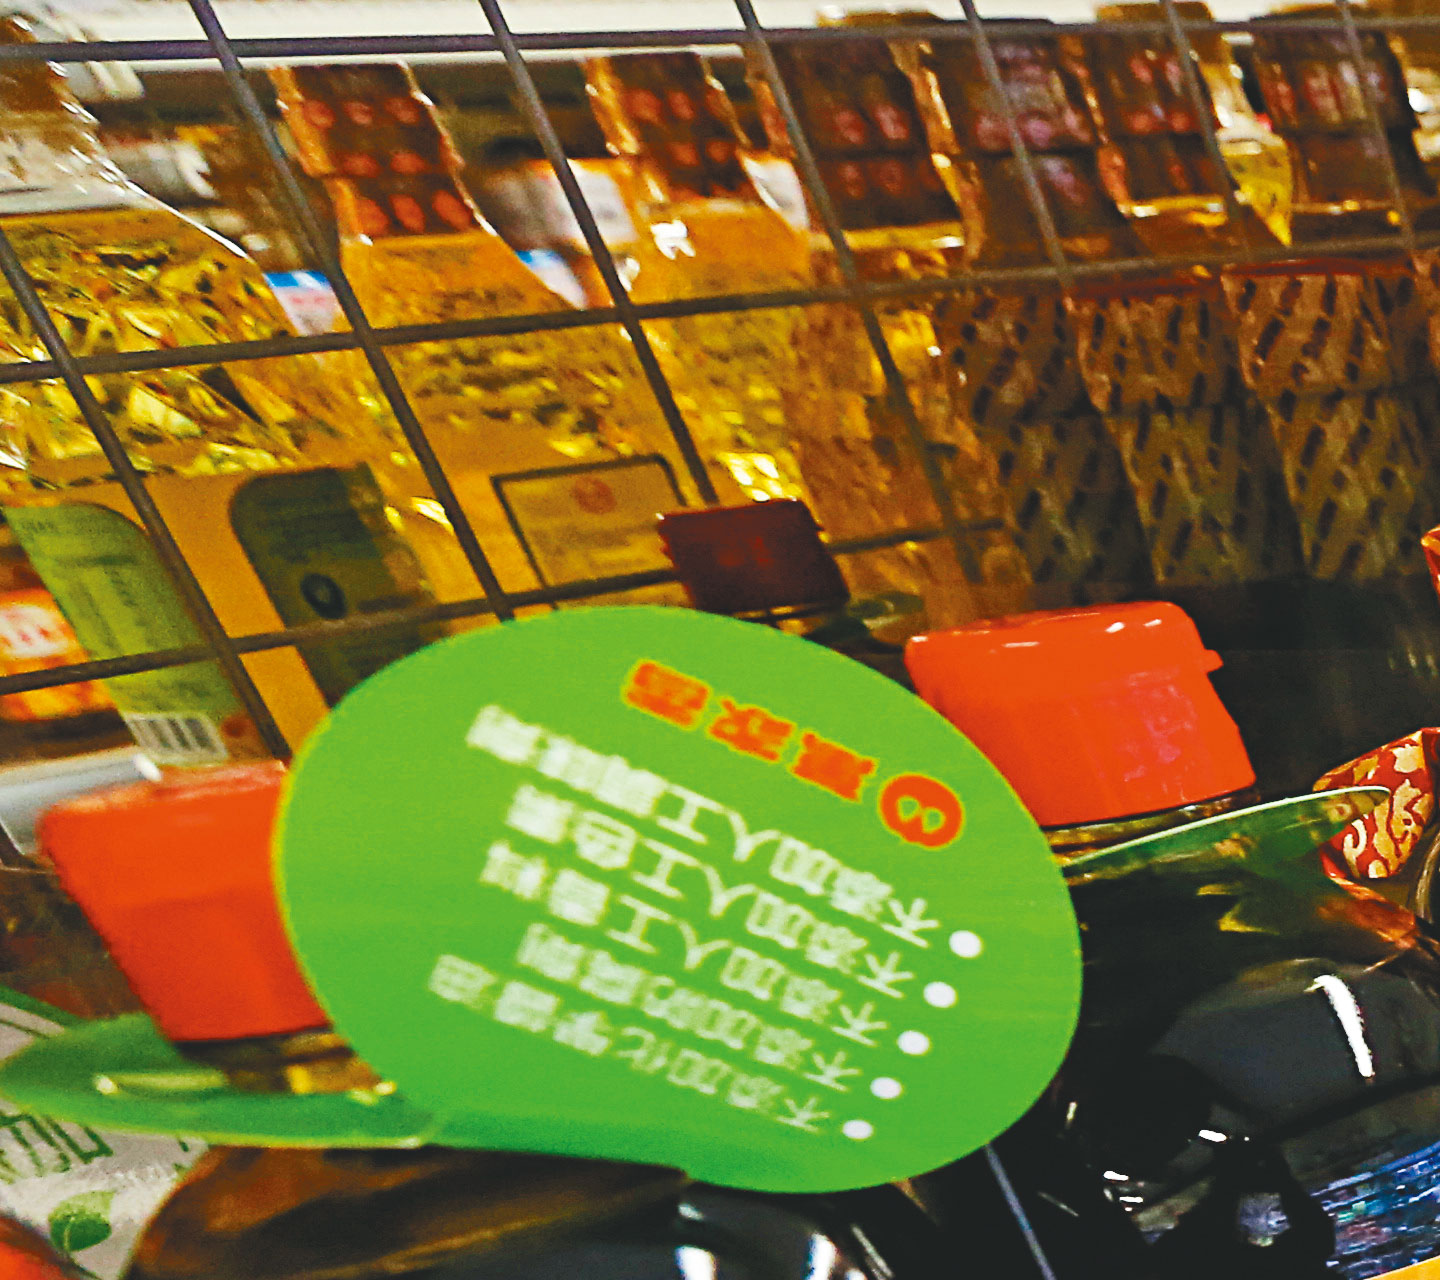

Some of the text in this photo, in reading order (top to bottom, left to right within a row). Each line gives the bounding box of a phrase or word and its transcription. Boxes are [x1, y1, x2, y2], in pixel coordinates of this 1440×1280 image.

[480, 840, 889, 1048] 不添加人工香料
[506, 784, 916, 999] 不添加人工色素
[518, 922, 860, 1092] 不添加防腐劑
